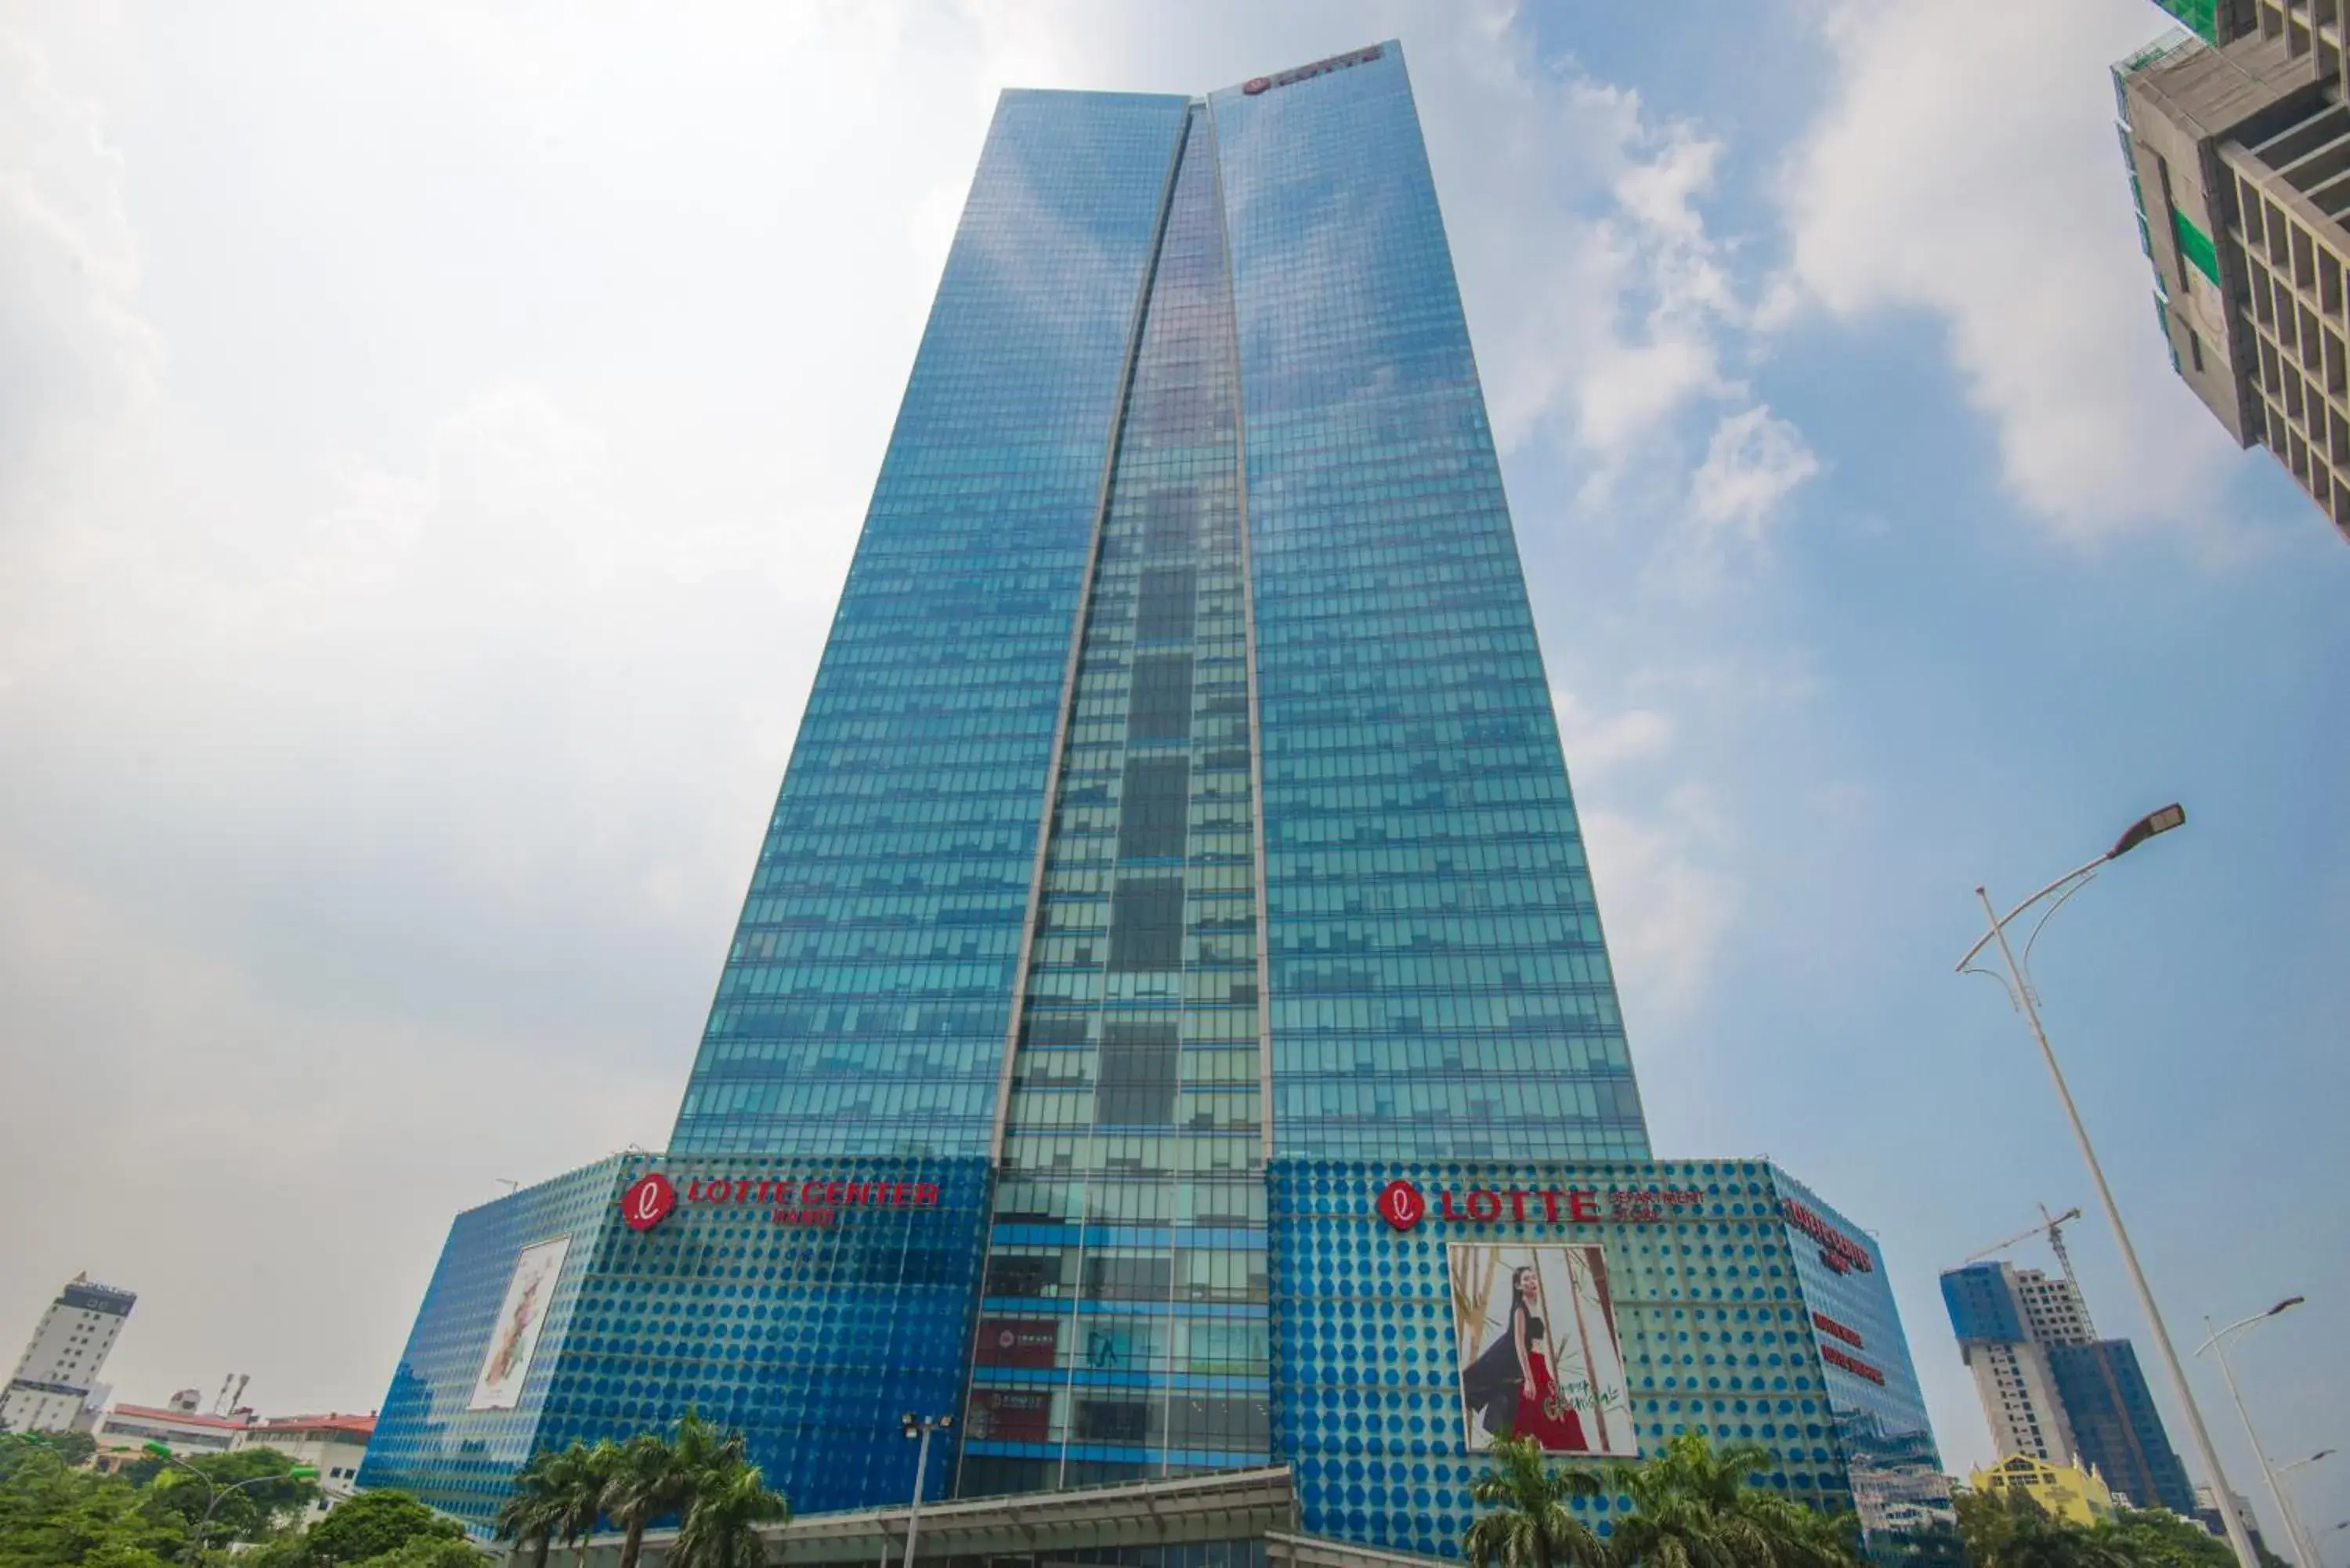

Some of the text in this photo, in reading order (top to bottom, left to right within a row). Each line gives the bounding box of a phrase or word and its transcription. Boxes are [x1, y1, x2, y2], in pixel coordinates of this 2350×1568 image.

[688, 1179, 793, 1204] LOTTE
[801, 1180, 939, 1205] CENTER
[1441, 1189, 1601, 1223] LOTTE
